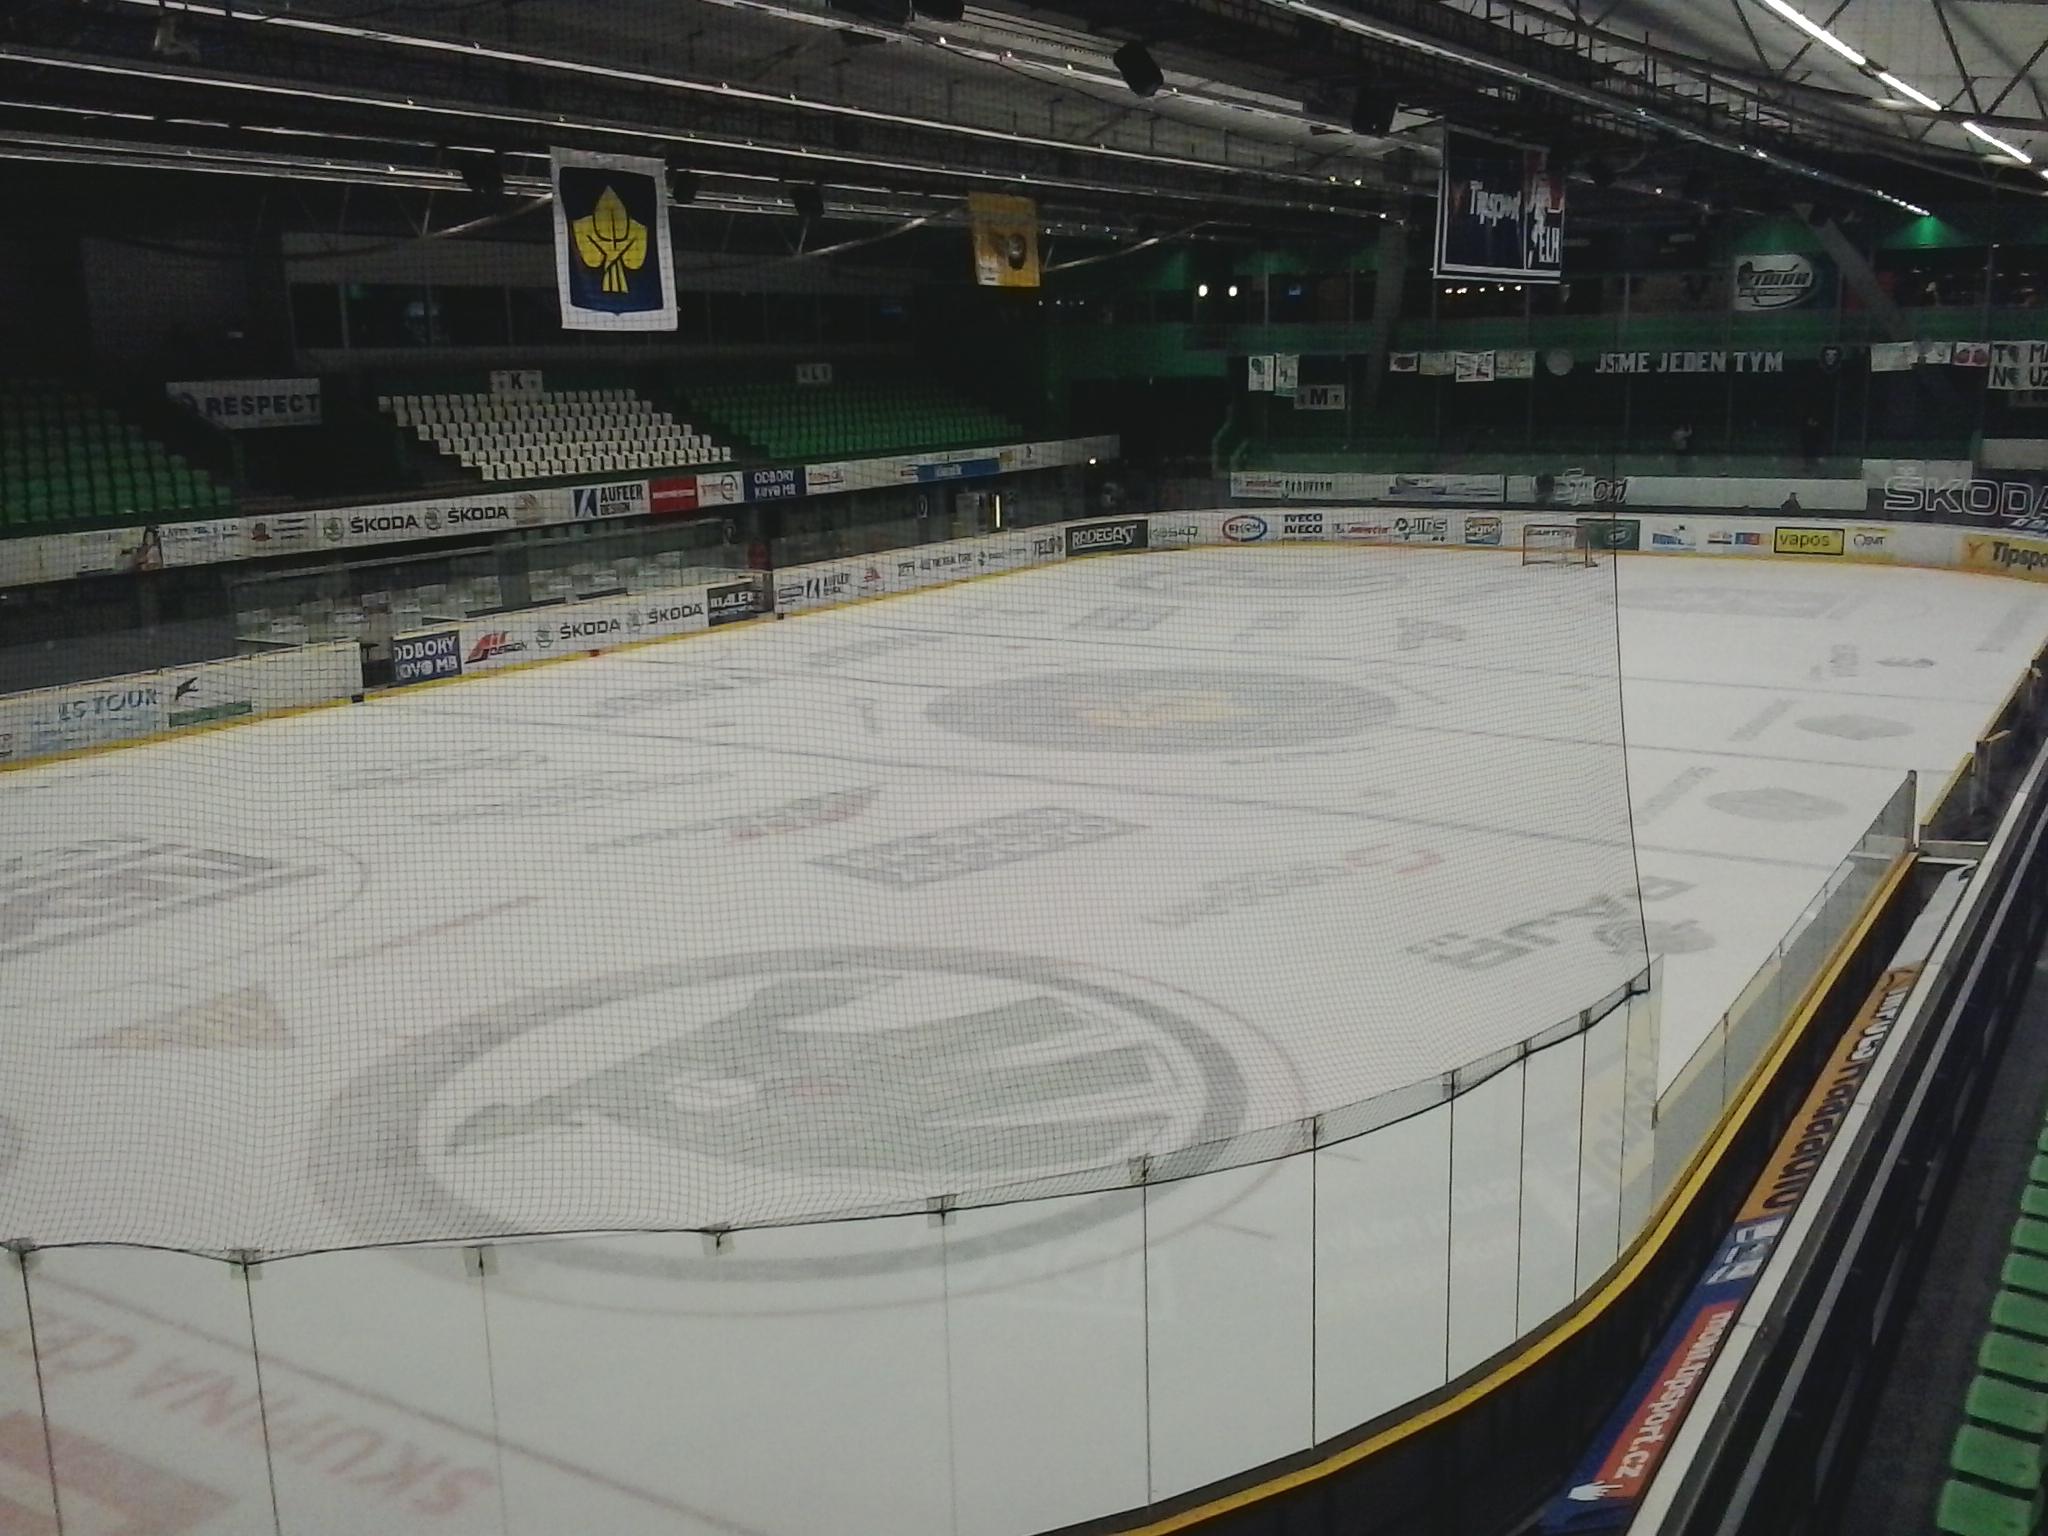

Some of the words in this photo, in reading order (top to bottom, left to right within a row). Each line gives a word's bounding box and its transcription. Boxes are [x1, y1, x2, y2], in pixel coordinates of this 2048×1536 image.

[1595, 352, 1650, 374] JSME
[1656, 351, 1727, 373] JEDEN
[206, 393, 320, 416] RESPECT
[350, 513, 421, 535] ŠKODA
[447, 503, 509, 524] ŠKODA
[1284, 513, 1323, 523] IVECO
[1284, 524, 1323, 534] IVECO
[1072, 525, 1137, 548] RADEGAST
[1779, 534, 1830, 548] vapos
[560, 617, 621, 639] ŠKODA
[649, 603, 704, 624] ŠKODA
